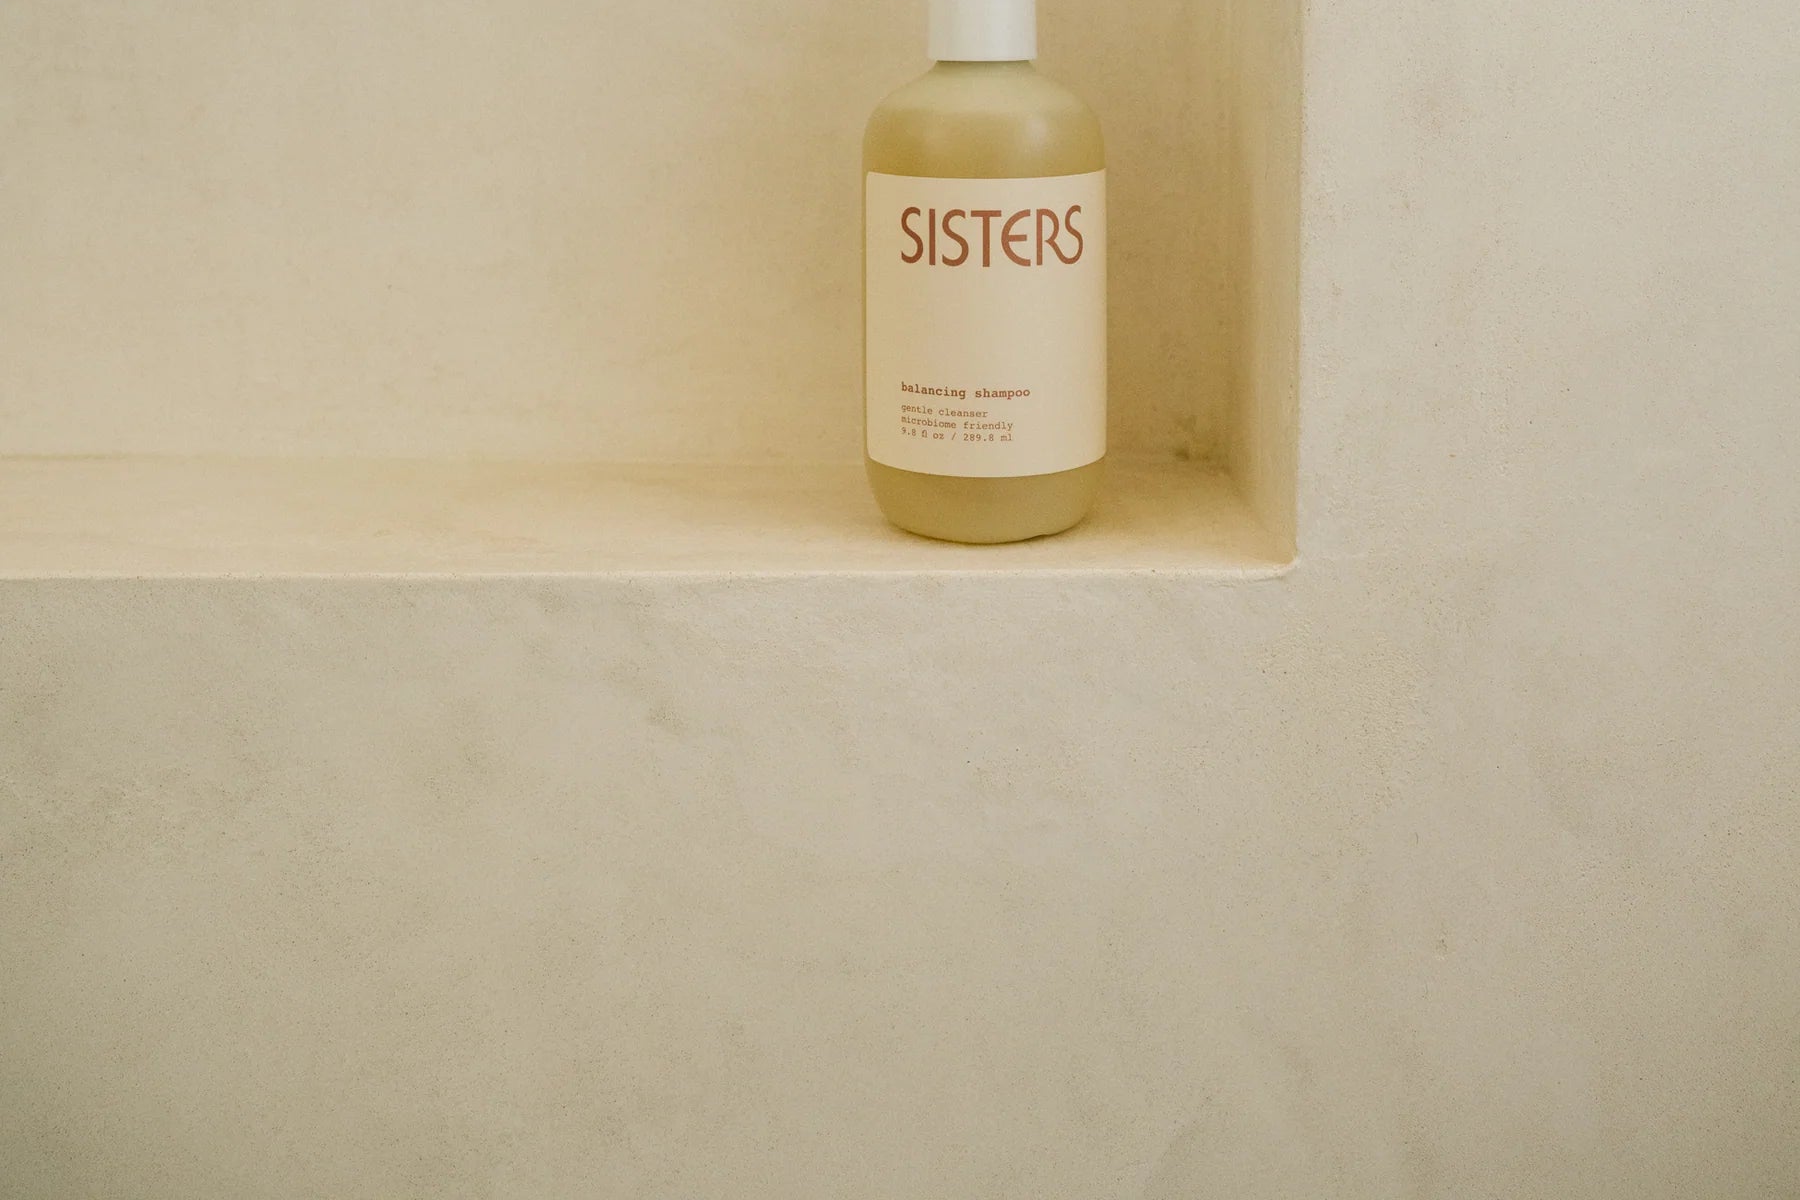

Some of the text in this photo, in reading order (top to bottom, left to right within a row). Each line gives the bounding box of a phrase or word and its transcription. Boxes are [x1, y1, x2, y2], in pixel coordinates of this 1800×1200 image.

[901, 205, 1084, 267] SISTERS
[901, 381, 1031, 400] balancing shampoo
[901, 404, 989, 418] gentle cleanser
[901, 416, 1013, 431] microbiome friendly
[901, 426, 917, 437] 9.8
[932, 432, 945, 440] oz
[963, 433, 994, 442] 289.8
[1000, 433, 1013, 441] ml
